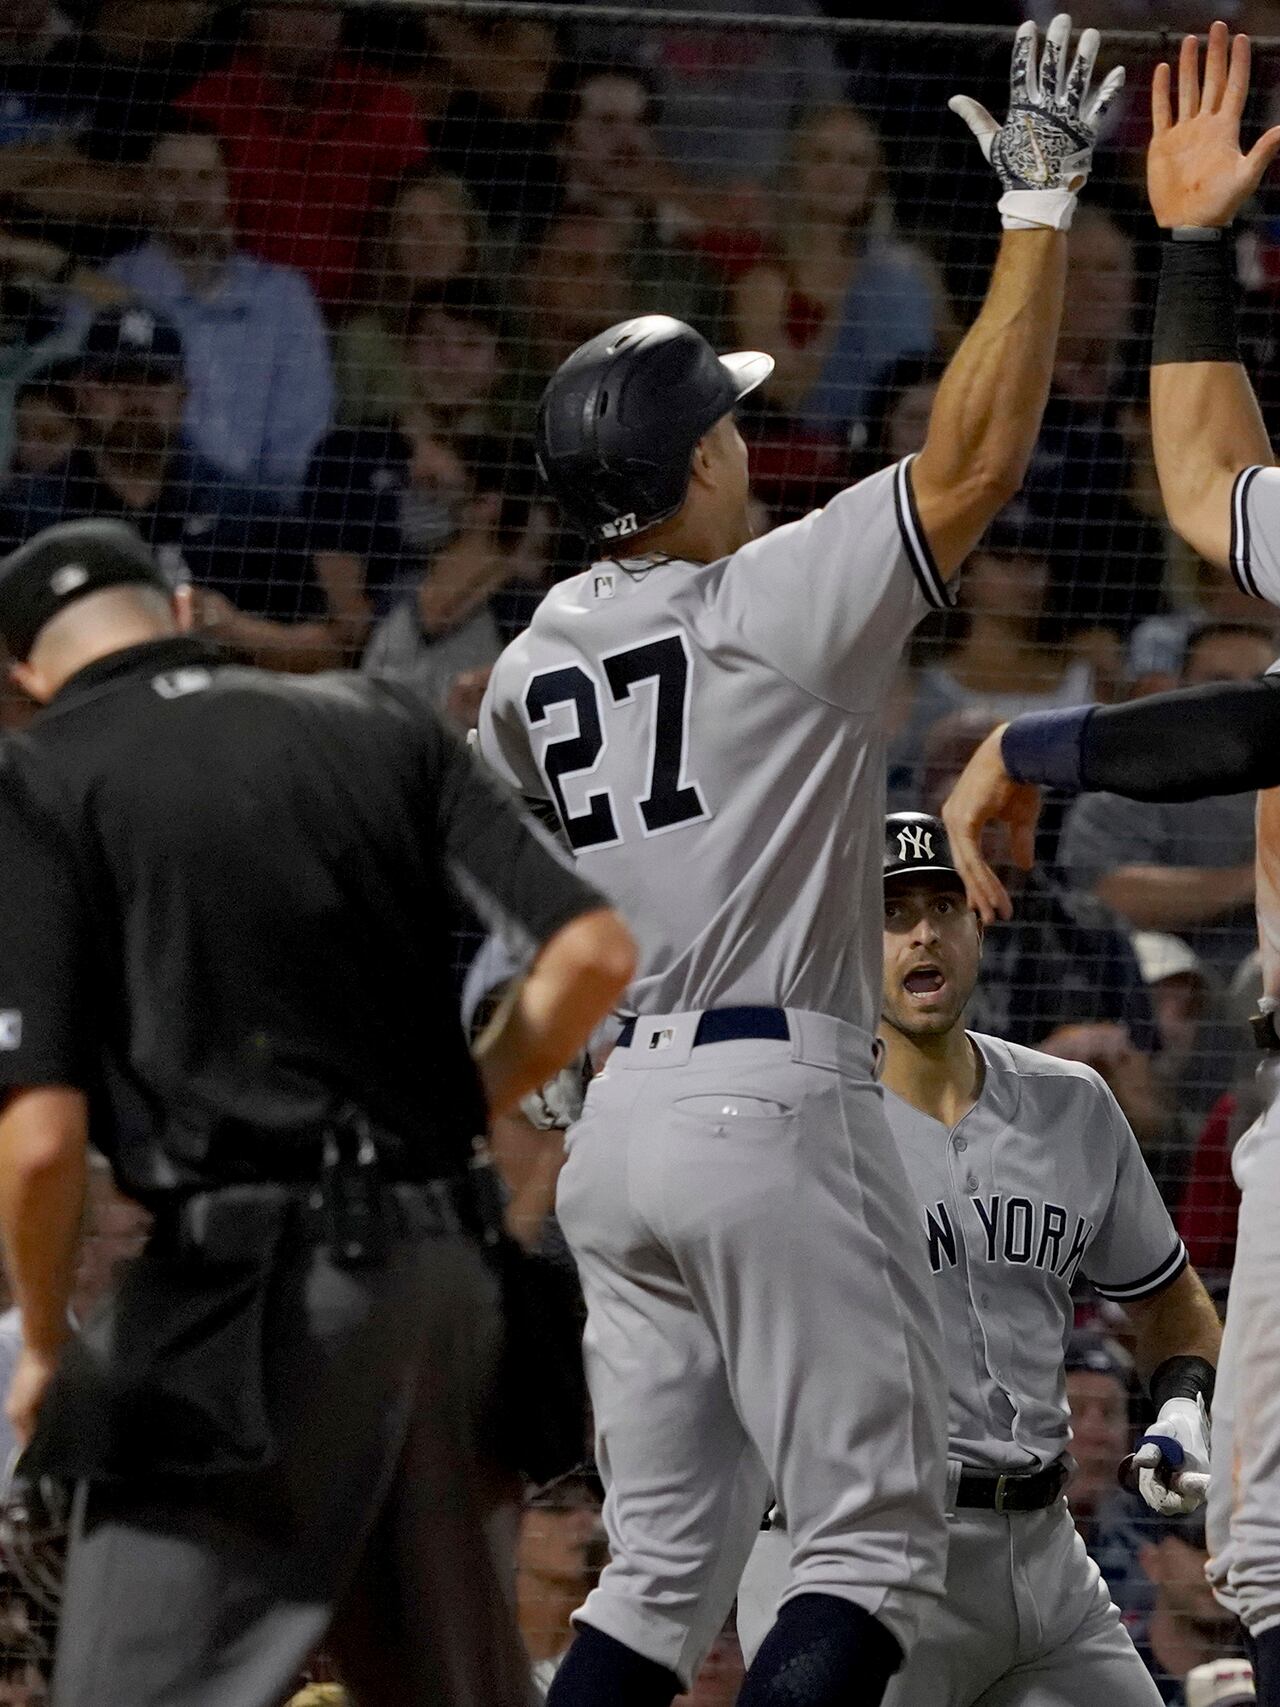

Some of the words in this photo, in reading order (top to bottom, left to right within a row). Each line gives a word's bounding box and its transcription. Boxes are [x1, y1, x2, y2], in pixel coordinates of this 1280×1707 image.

[613, 512, 638, 536] 27
[523, 627, 712, 856] 27
[896, 825, 936, 861] NY
[969, 1194, 1094, 1288] YORK
